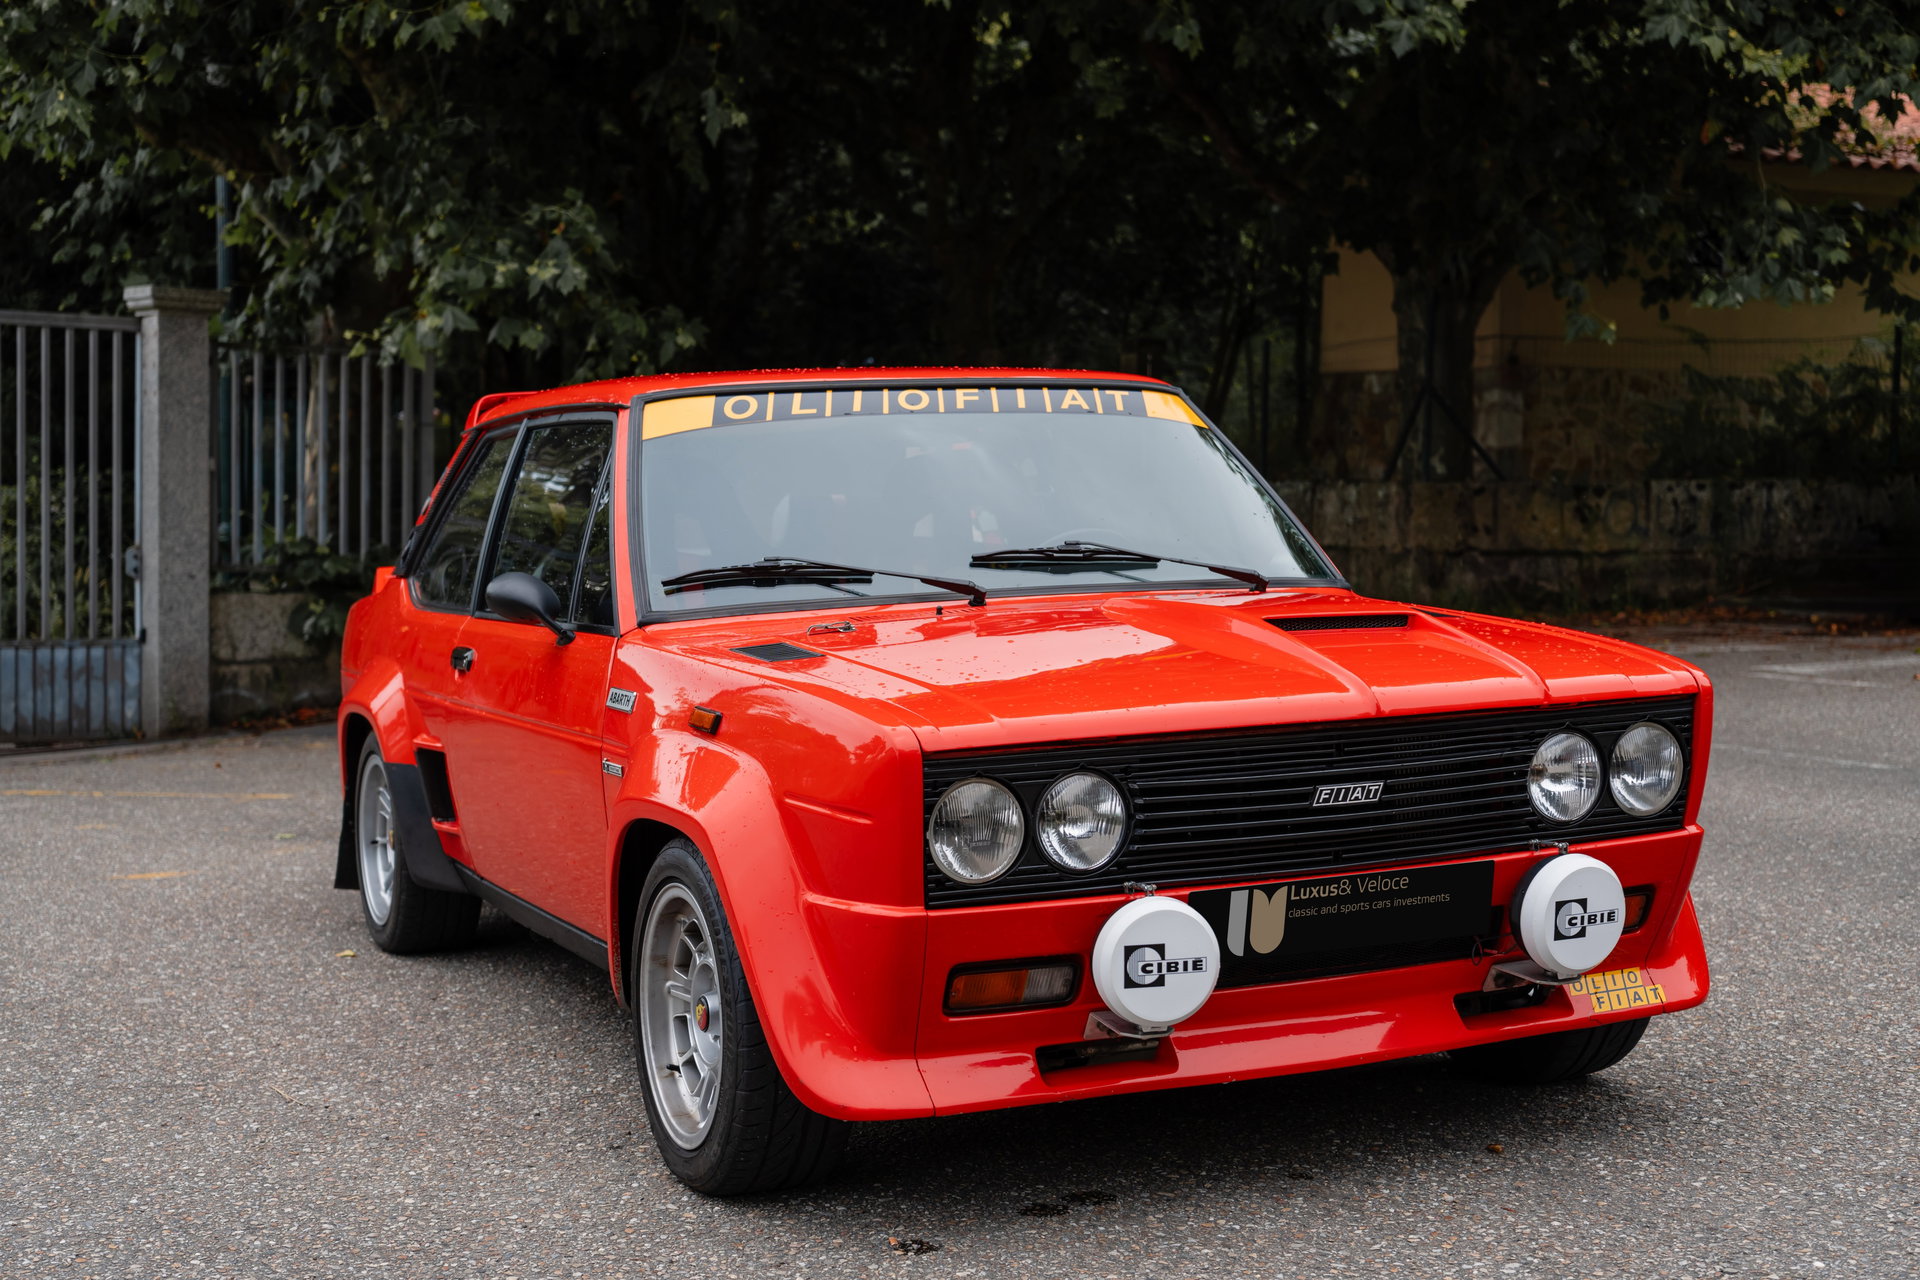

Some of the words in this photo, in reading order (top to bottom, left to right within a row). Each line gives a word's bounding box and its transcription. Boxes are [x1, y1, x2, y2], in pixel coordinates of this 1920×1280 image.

[609, 691, 632, 707] ABARTH
[1319, 785, 1380, 803] FIAT
[1357, 875, 1409, 893] Veloce
[1288, 905, 1318, 918] classic
[1320, 903, 1338, 915] and
[1340, 901, 1370, 914] sports
[1372, 899, 1391, 909] cars
[1393, 893, 1450, 907] investments
[1572, 970, 1638, 992] OLIO
[1597, 987, 1660, 1009] FIAT
